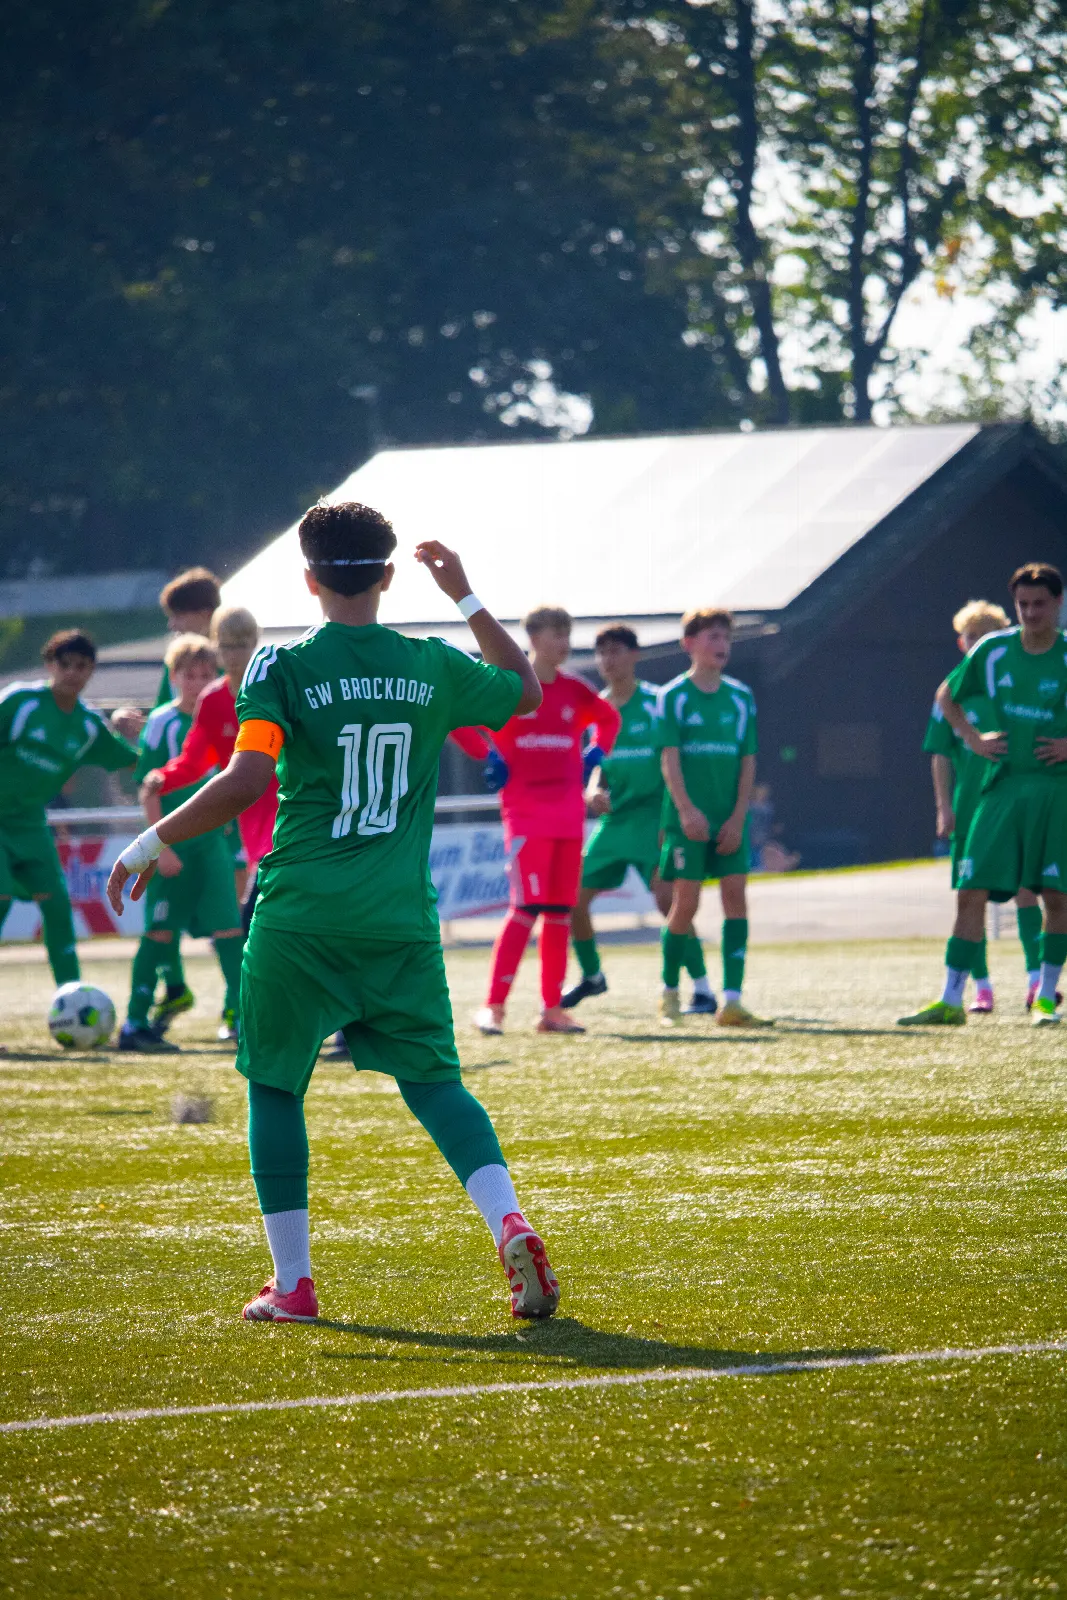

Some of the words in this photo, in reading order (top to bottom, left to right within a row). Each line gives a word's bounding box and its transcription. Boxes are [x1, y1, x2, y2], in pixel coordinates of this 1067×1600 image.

[304, 681, 333, 709] GW
[339, 677, 435, 707] BROCKDORF
[331, 722, 413, 839] 10
